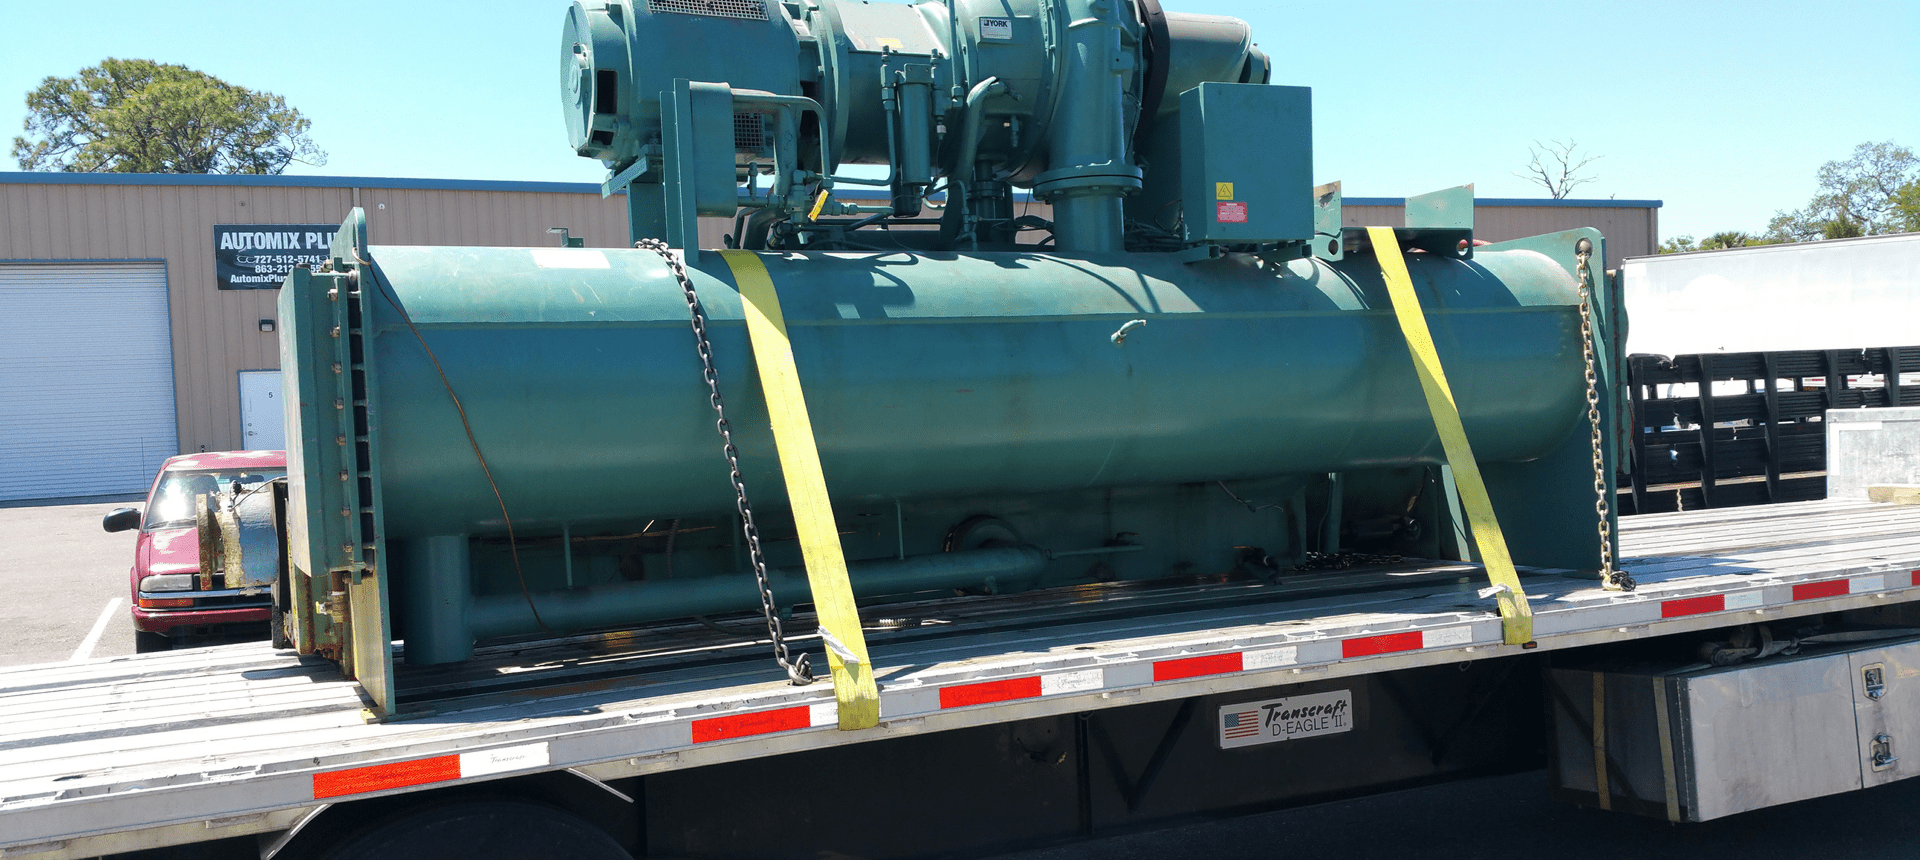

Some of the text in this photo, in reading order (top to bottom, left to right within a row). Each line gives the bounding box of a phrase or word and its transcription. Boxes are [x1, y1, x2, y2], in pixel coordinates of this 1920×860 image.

[220, 232, 337, 250] AUTOMIX PLU
[254, 255, 320, 263] 727-512-5741
[268, 391, 274, 399] 5
[1261, 700, 1348, 728] Transcraft
[1272, 716, 1329, 736] D-EAGLE
